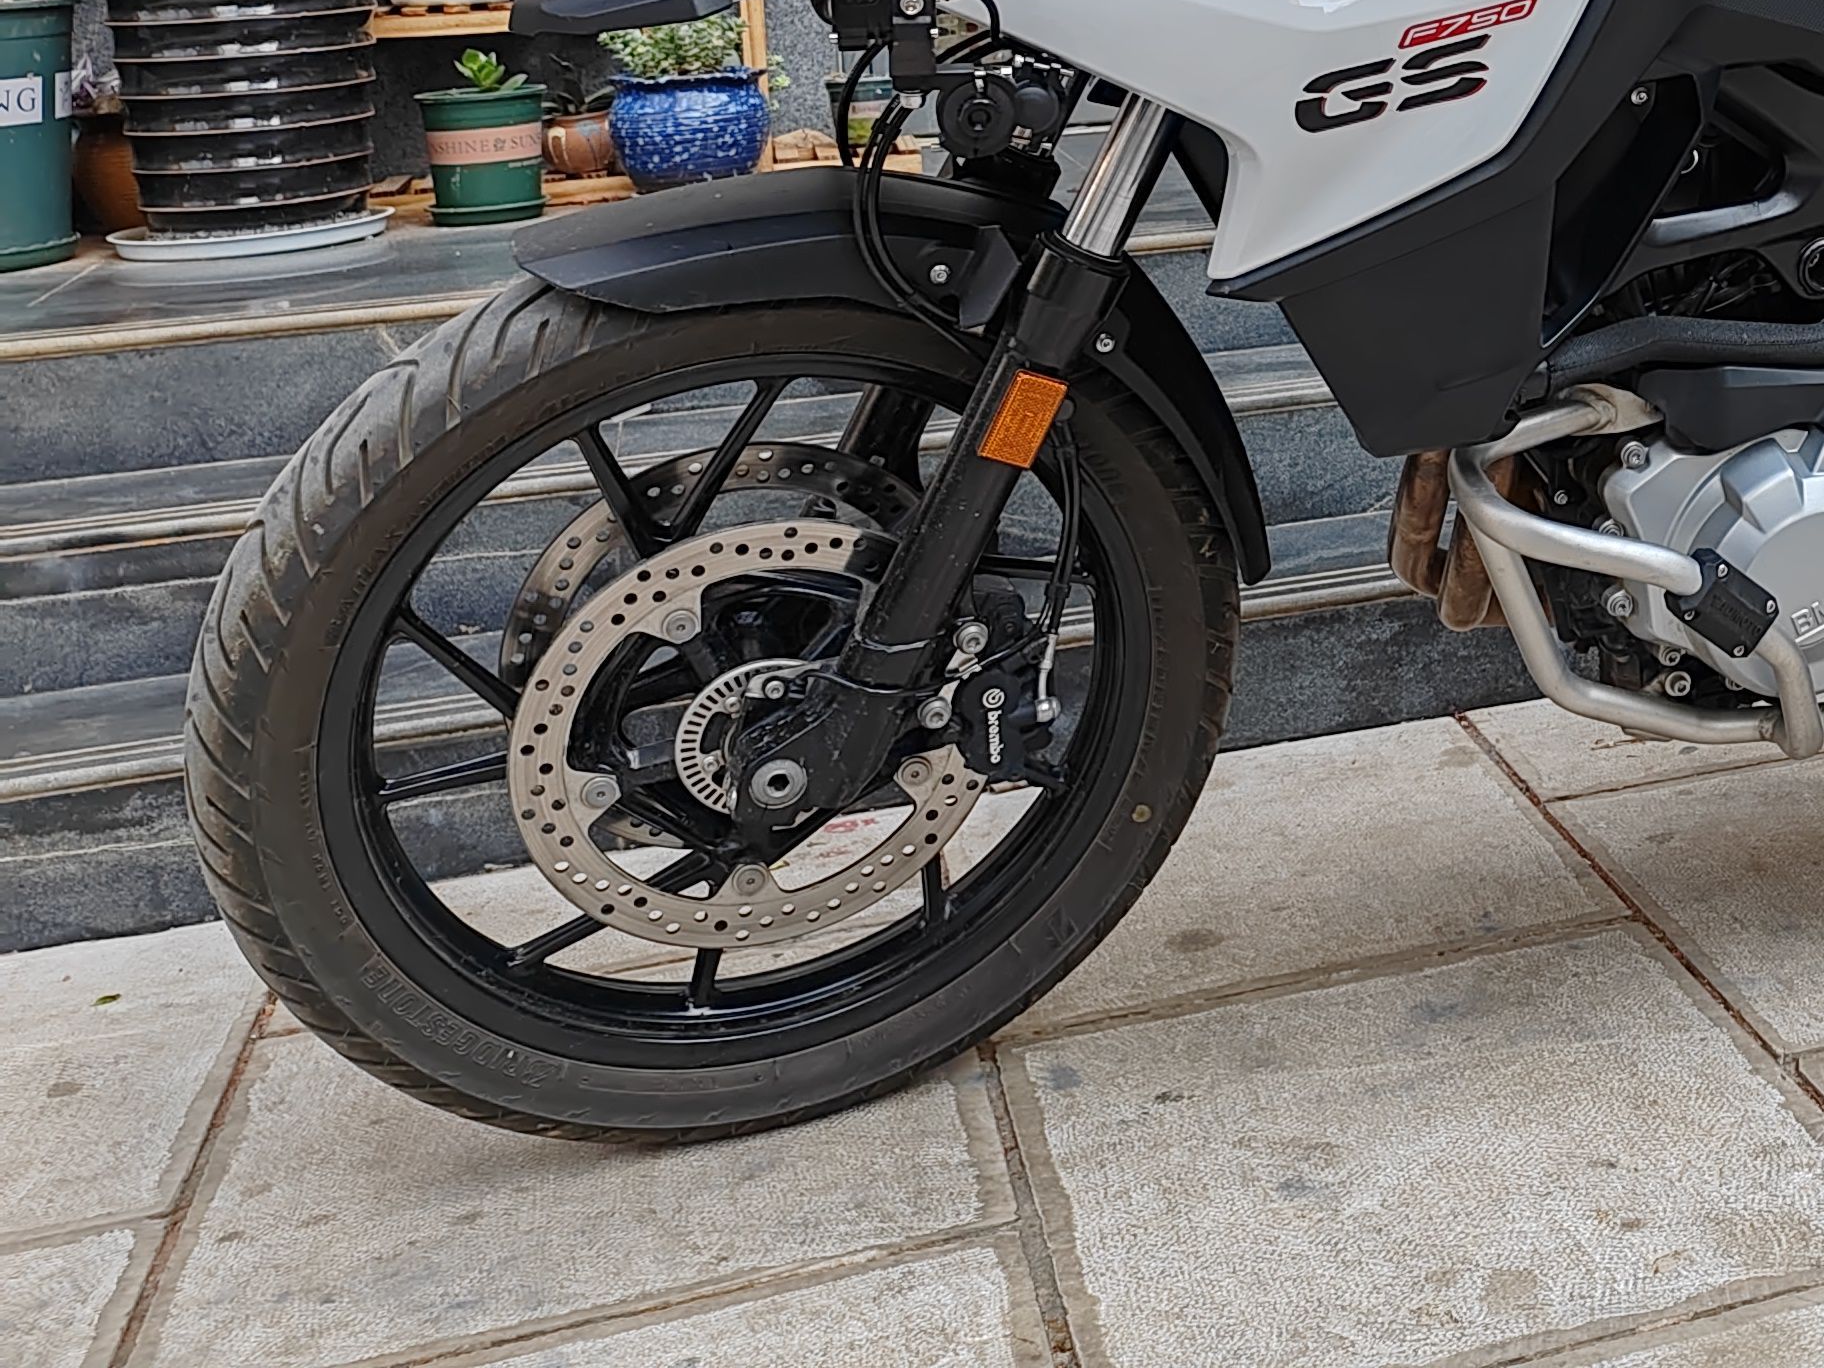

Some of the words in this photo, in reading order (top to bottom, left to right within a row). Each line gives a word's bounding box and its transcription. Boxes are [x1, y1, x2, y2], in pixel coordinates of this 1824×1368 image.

[1402, 0, 1532, 47] F750
[1294, 34, 1492, 132] GS
[987, 709, 1004, 764] brembo
